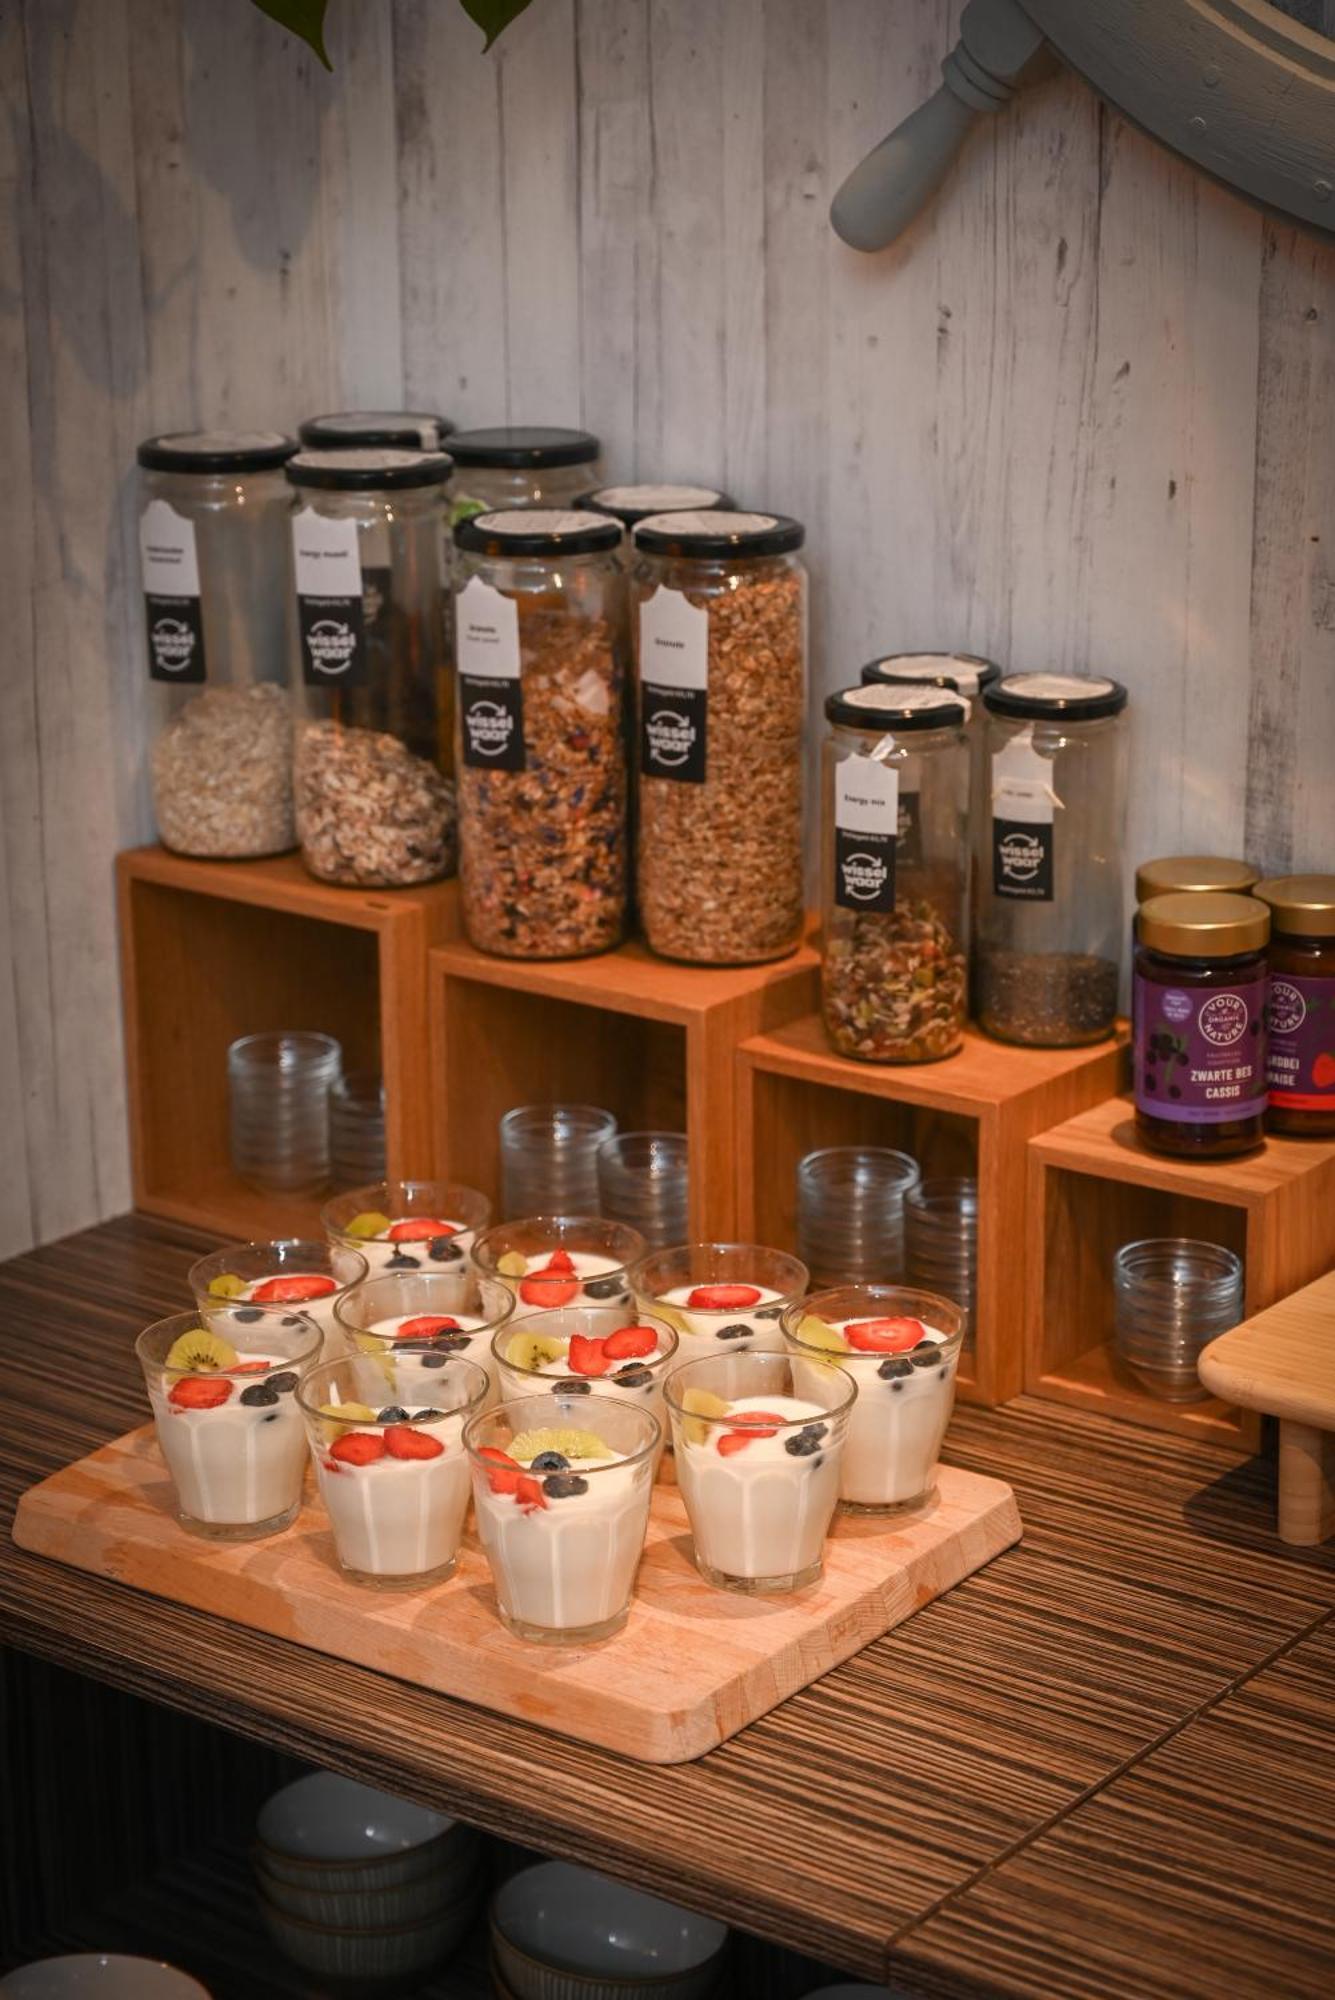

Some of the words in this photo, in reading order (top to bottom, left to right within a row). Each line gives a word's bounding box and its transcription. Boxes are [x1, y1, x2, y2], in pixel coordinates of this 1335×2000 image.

[465, 711, 513, 731] wissel
[469, 727, 511, 742] waar
[646, 720, 696, 741] wissel
[650, 737, 692, 752] waar
[998, 842, 1044, 860] wissel
[841, 861, 887, 879] wissel
[1001, 855, 1041, 869] waar
[844, 875, 884, 889] waar
[1204, 1022, 1244, 1041] NATURE
[1191, 1068, 1234, 1082] ZWARTE
[1235, 1065, 1252, 1080] BES
[1205, 1085, 1241, 1099] CASSIS
